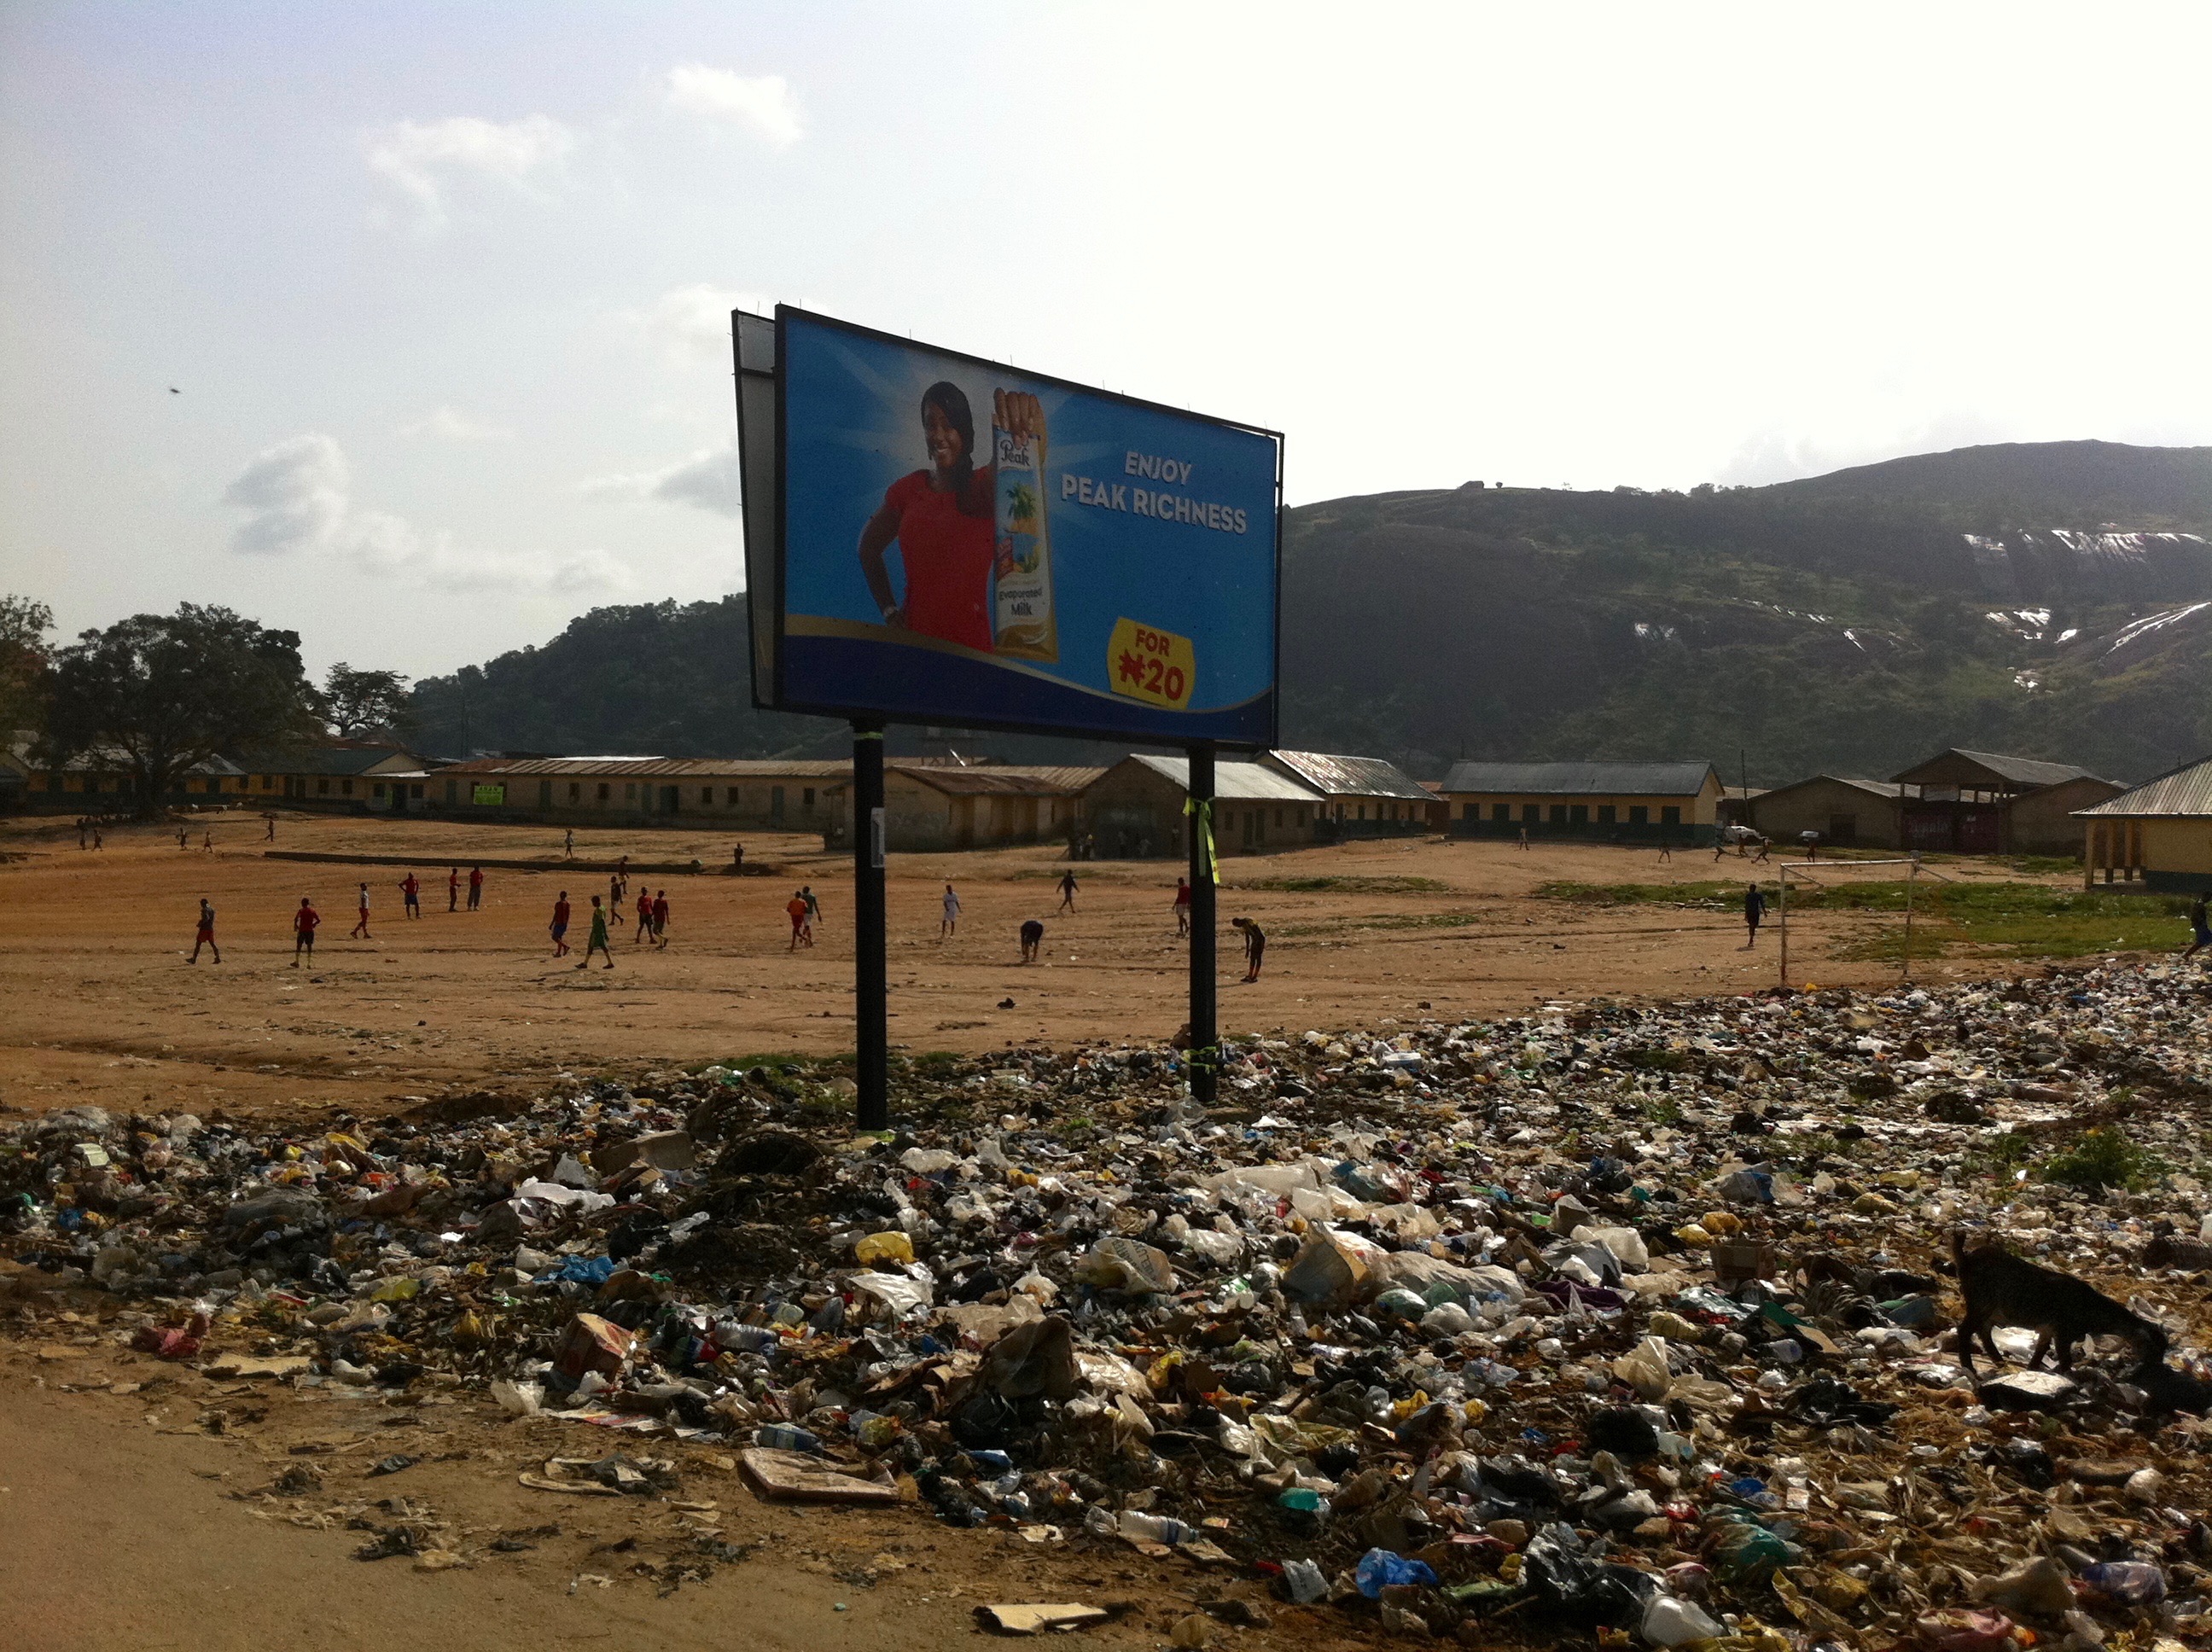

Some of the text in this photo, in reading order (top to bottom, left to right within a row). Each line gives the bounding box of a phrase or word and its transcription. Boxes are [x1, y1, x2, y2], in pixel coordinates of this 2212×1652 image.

[999, 439, 1031, 467] Peak
[1124, 450, 1192, 486] ENJOY
[1061, 473, 1248, 535] PEAK RICHNESS
[1010, 601, 1033, 616] Milk
[1135, 628, 1170, 657] FOR
